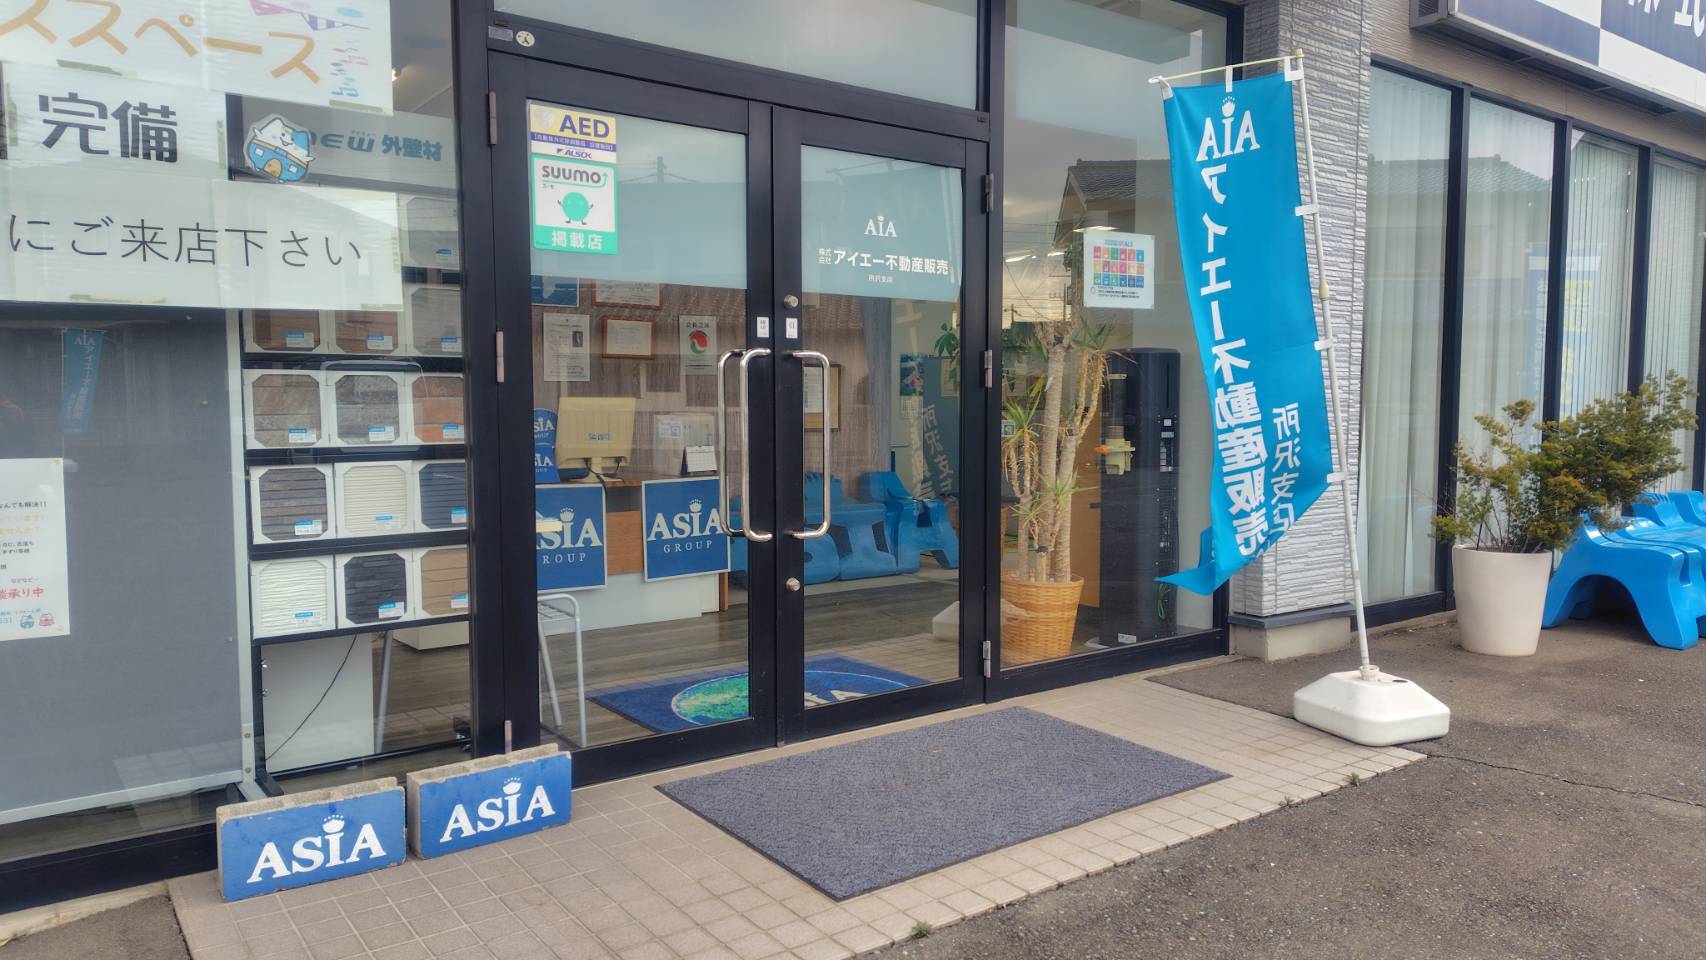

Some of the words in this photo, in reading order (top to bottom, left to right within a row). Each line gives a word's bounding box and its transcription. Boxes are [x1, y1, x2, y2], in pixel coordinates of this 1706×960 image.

[39, 91, 178, 163] 完備
[559, 113, 610, 138] AED
[381, 134, 443, 161] 外壁材
[8, 213, 361, 267] にご来店下さい
[551, 230, 602, 250] 掲載店
[663, 539, 713, 554] GROUP
[440, 785, 556, 843] ASIA
[246, 822, 387, 884] ASIA
